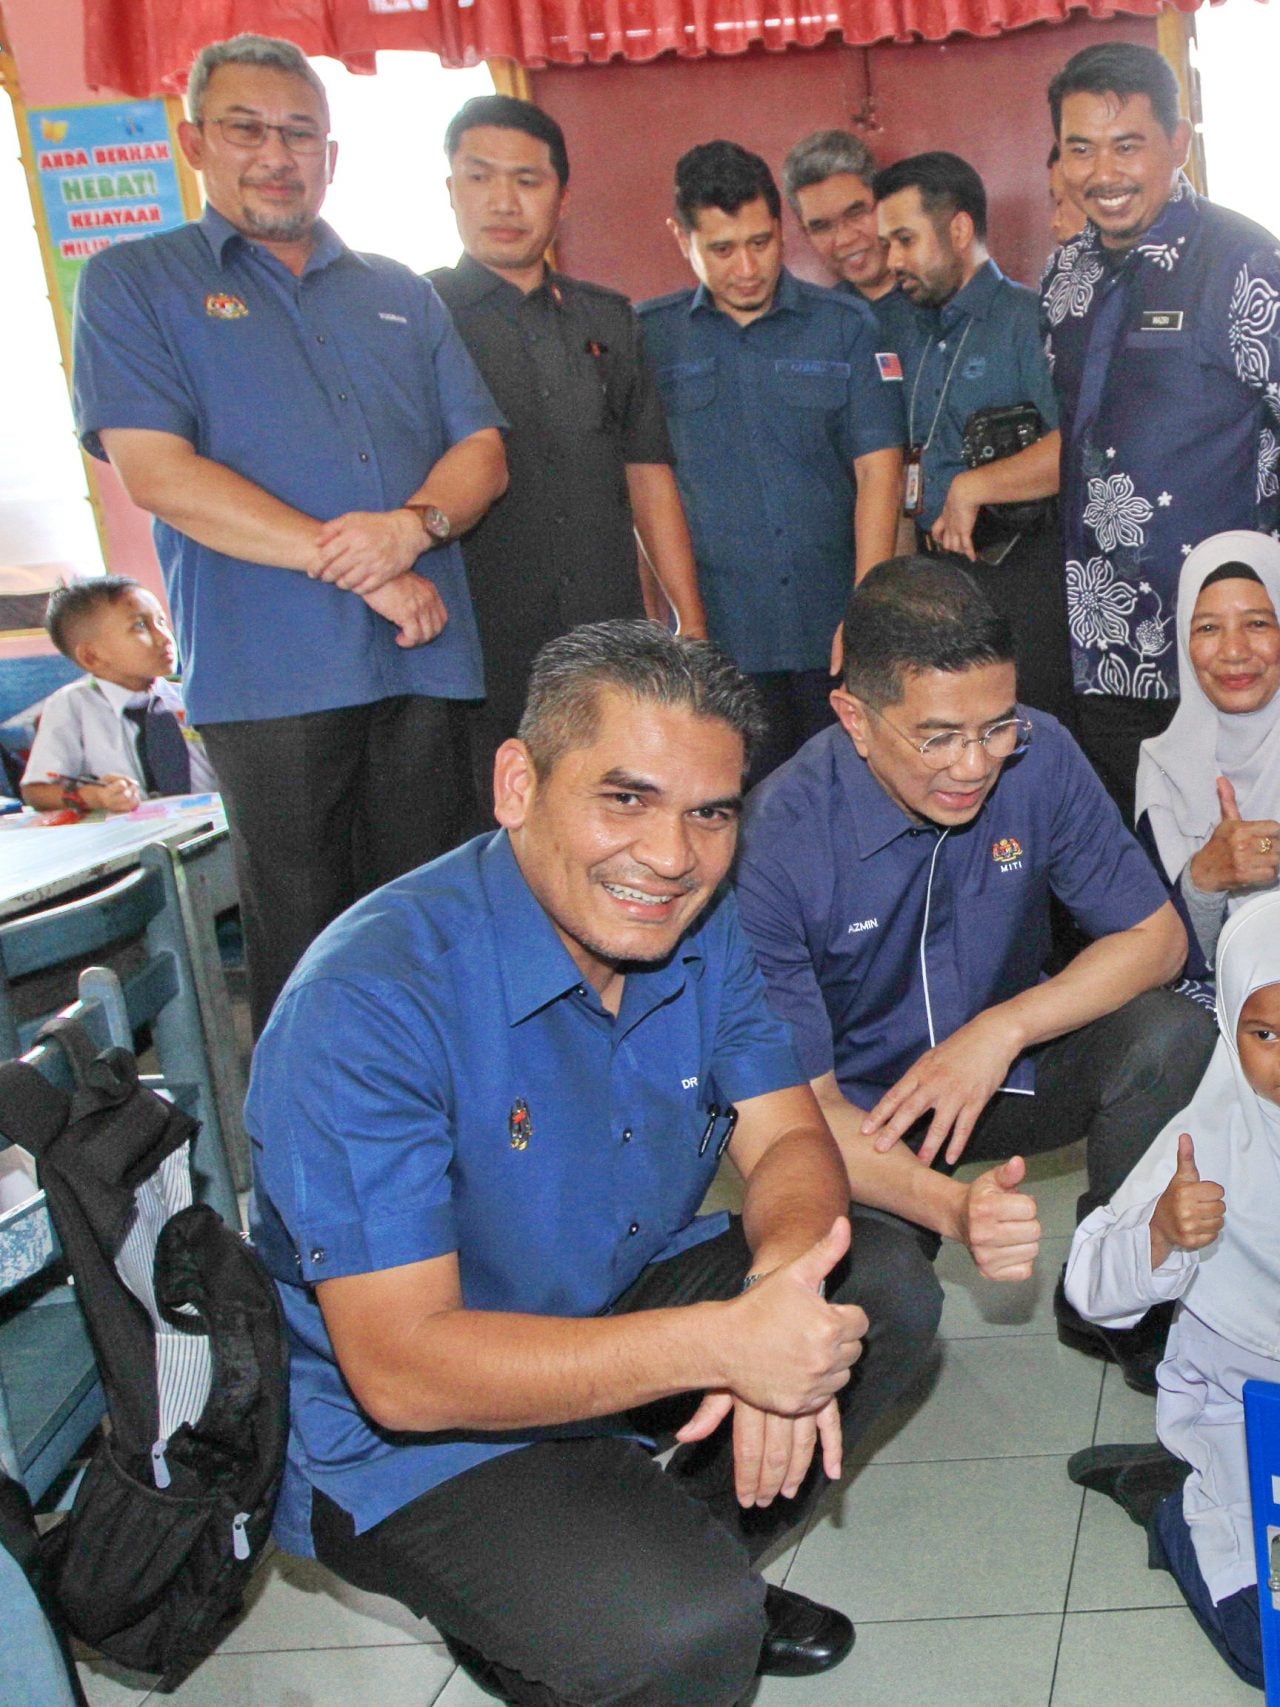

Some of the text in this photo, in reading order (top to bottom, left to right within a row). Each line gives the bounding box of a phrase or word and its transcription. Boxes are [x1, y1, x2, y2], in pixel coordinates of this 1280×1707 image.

[41, 144, 169, 169] ANDA BERHAK
[62, 171, 156, 202] HEBAT!
[71, 207, 161, 228] KEJAYAAN
[1000, 860, 1023, 873] MITI
[848, 917, 879, 934] AZMIN
[681, 1076, 699, 1090] DR
